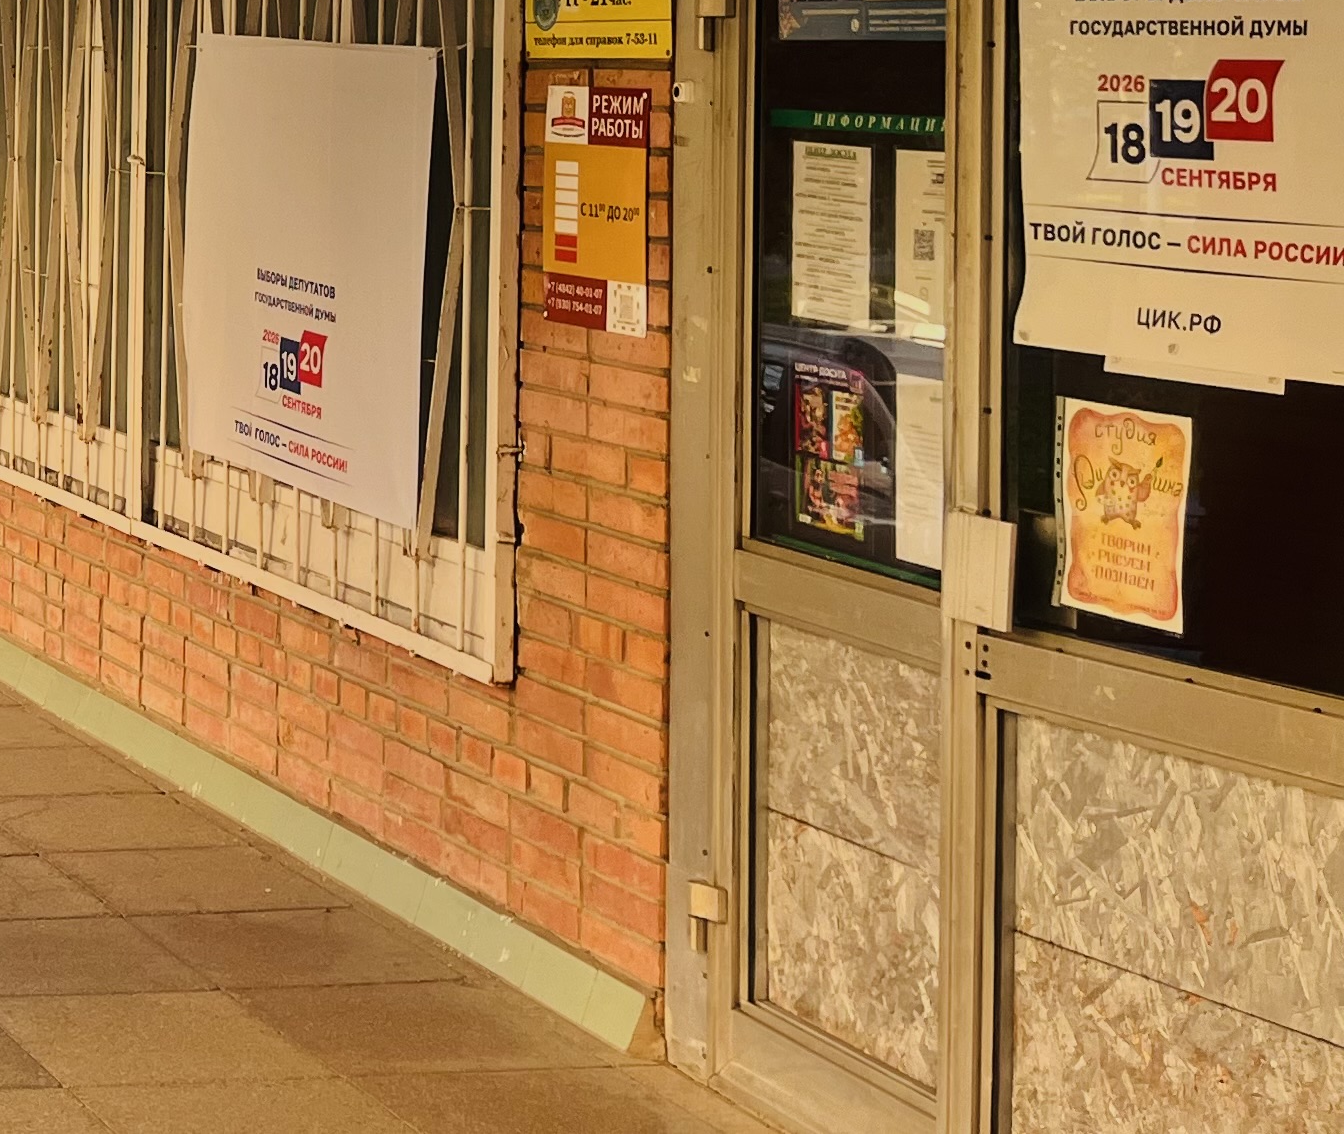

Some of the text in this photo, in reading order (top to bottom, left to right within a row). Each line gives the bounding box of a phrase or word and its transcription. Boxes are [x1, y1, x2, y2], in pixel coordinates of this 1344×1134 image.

[534, 33, 658, 48] телефон для справок 7-53-11
[1069, 16, 1308, 39] ГОСУДАРСТВЕННОЙ ДУМЫ
[1097, 74, 1145, 93] 2026
[592, 94, 645, 115] РЕЖИМ
[591, 117, 644, 140] РАБОТЫ
[813, 112, 946, 132] ИНФОРМАЦИ
[1104, 77, 1269, 165] 18 19 20
[1161, 167, 1277, 193] СЕНТЯБРЯ
[580, 202, 586, 217] С
[607, 205, 621, 223] ДО
[1029, 221, 1085, 244] ТВОЙ
[1090, 227, 1161, 250] ГОЛОС
[1187, 234, 1248, 258] СИЛА
[256, 268, 336, 299] ВЫБОРЫ ДЕПУТАТОВ
[254, 291, 337, 323] ГОСУДАРСТВЕННОЙ ДУМЫ
[1136, 306, 1222, 335] ЦИК.РФ
[263, 342, 321, 391] 18 19 20
[282, 394, 322, 420] СЕНТЯБРЯ
[234, 419, 252, 437] ТВОЙ
[254, 427, 280, 448] ГОЛОС
[288, 440, 310, 460] СИЛА
[311, 448, 348, 474] РОССИИ!
[1094, 417, 1157, 455] студия
[1101, 532, 1151, 556] ТВОРИМ
[1098, 548, 1151, 572] РИСУЕМ
